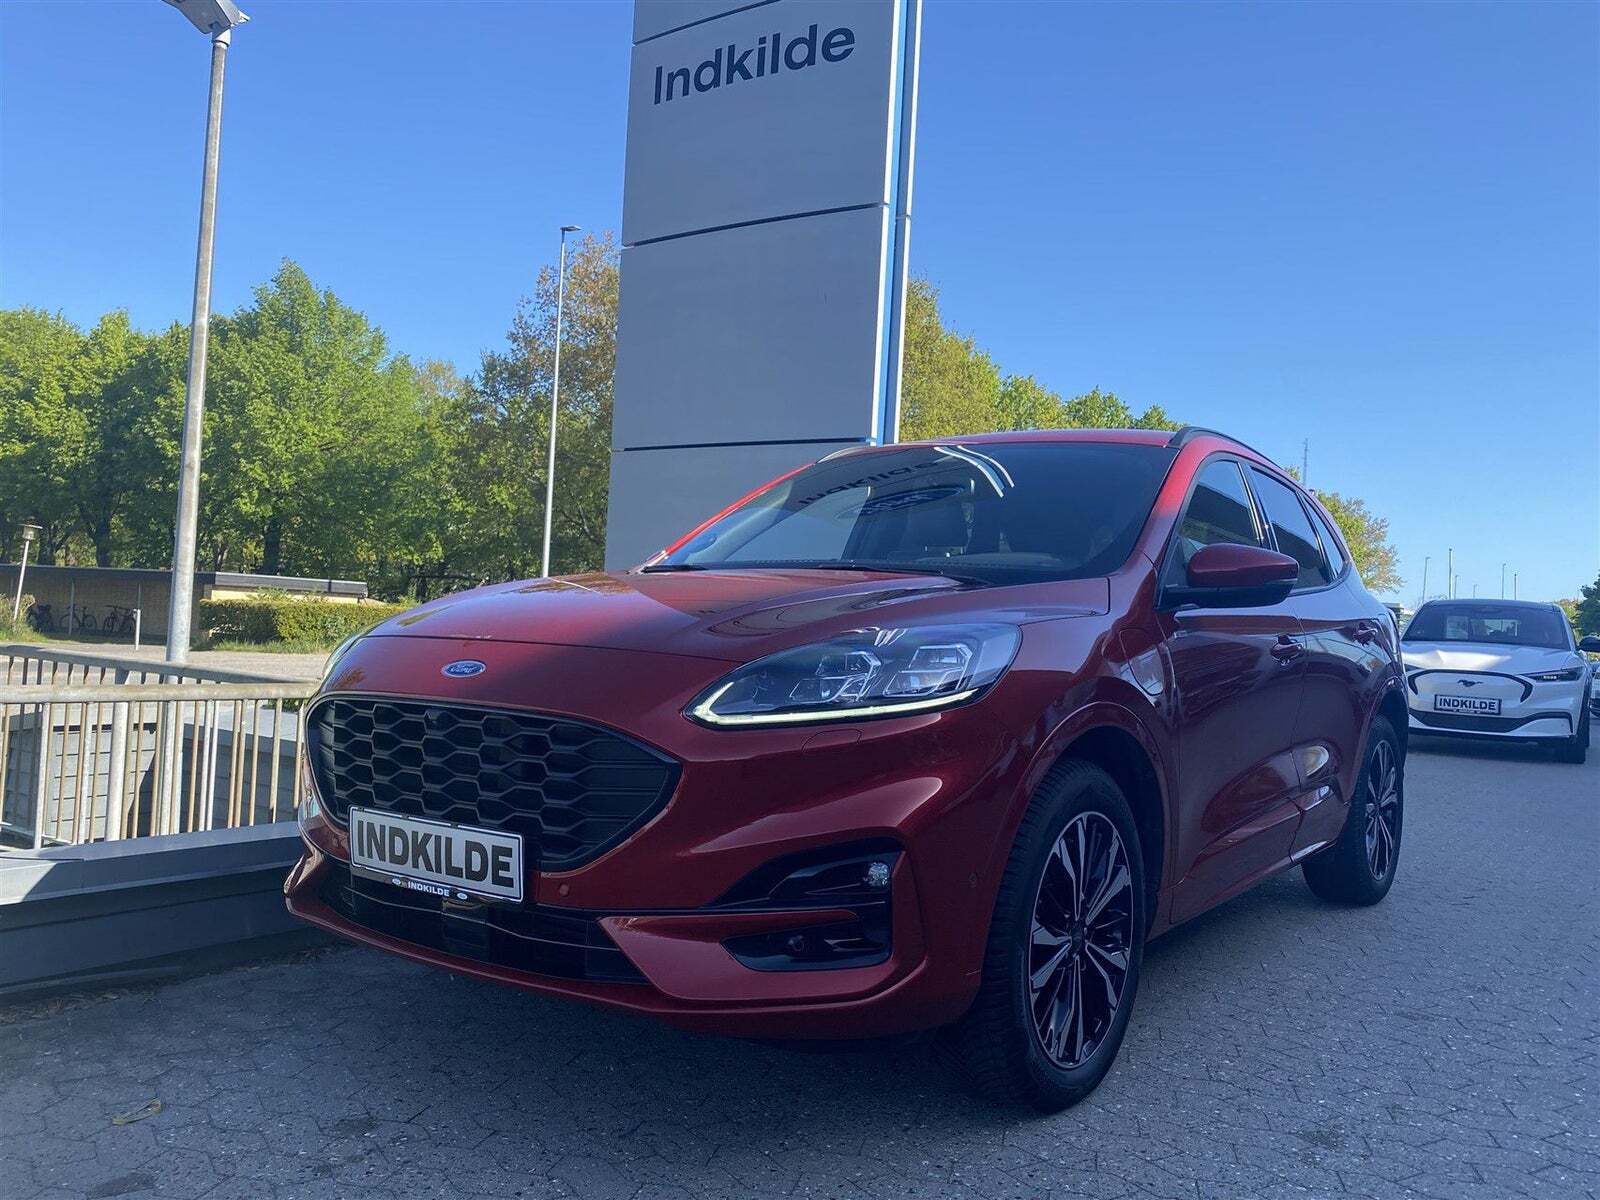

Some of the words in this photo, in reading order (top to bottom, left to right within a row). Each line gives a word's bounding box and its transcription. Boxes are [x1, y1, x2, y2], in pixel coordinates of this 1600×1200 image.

[653, 23, 856, 105] Indkilde
[1439, 697, 1497, 711] INDKILDE
[357, 820, 515, 889] INDKILDE
[407, 880, 450, 897] INDKILDE
